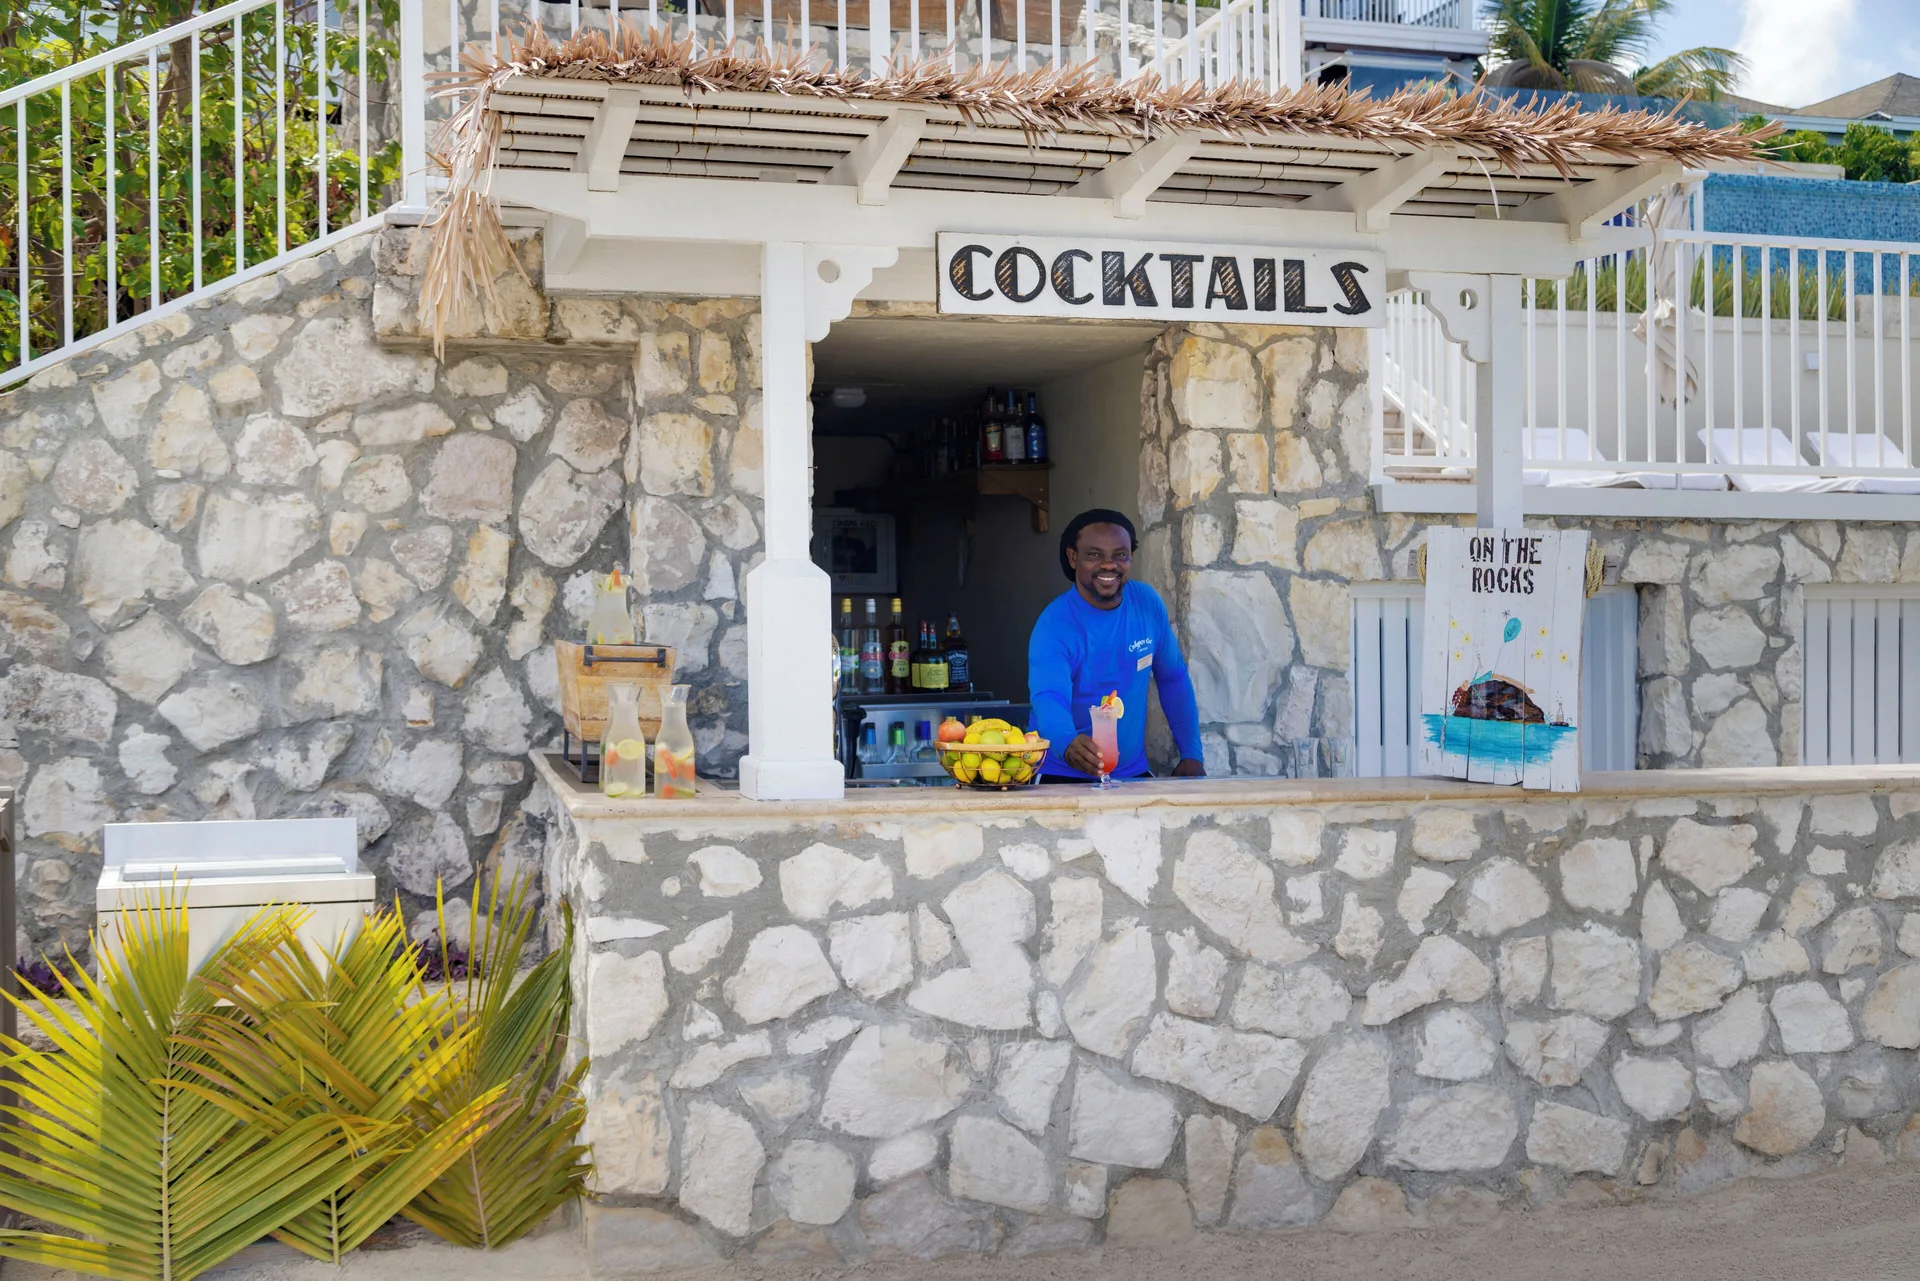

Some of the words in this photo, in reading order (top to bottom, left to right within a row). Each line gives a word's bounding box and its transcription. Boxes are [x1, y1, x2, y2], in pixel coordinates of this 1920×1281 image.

[949, 244, 1371, 316] COCKTAILS
[1469, 536, 1495, 563] ON
[1501, 537, 1543, 564] THE
[1472, 566, 1535, 595] ROCKS
